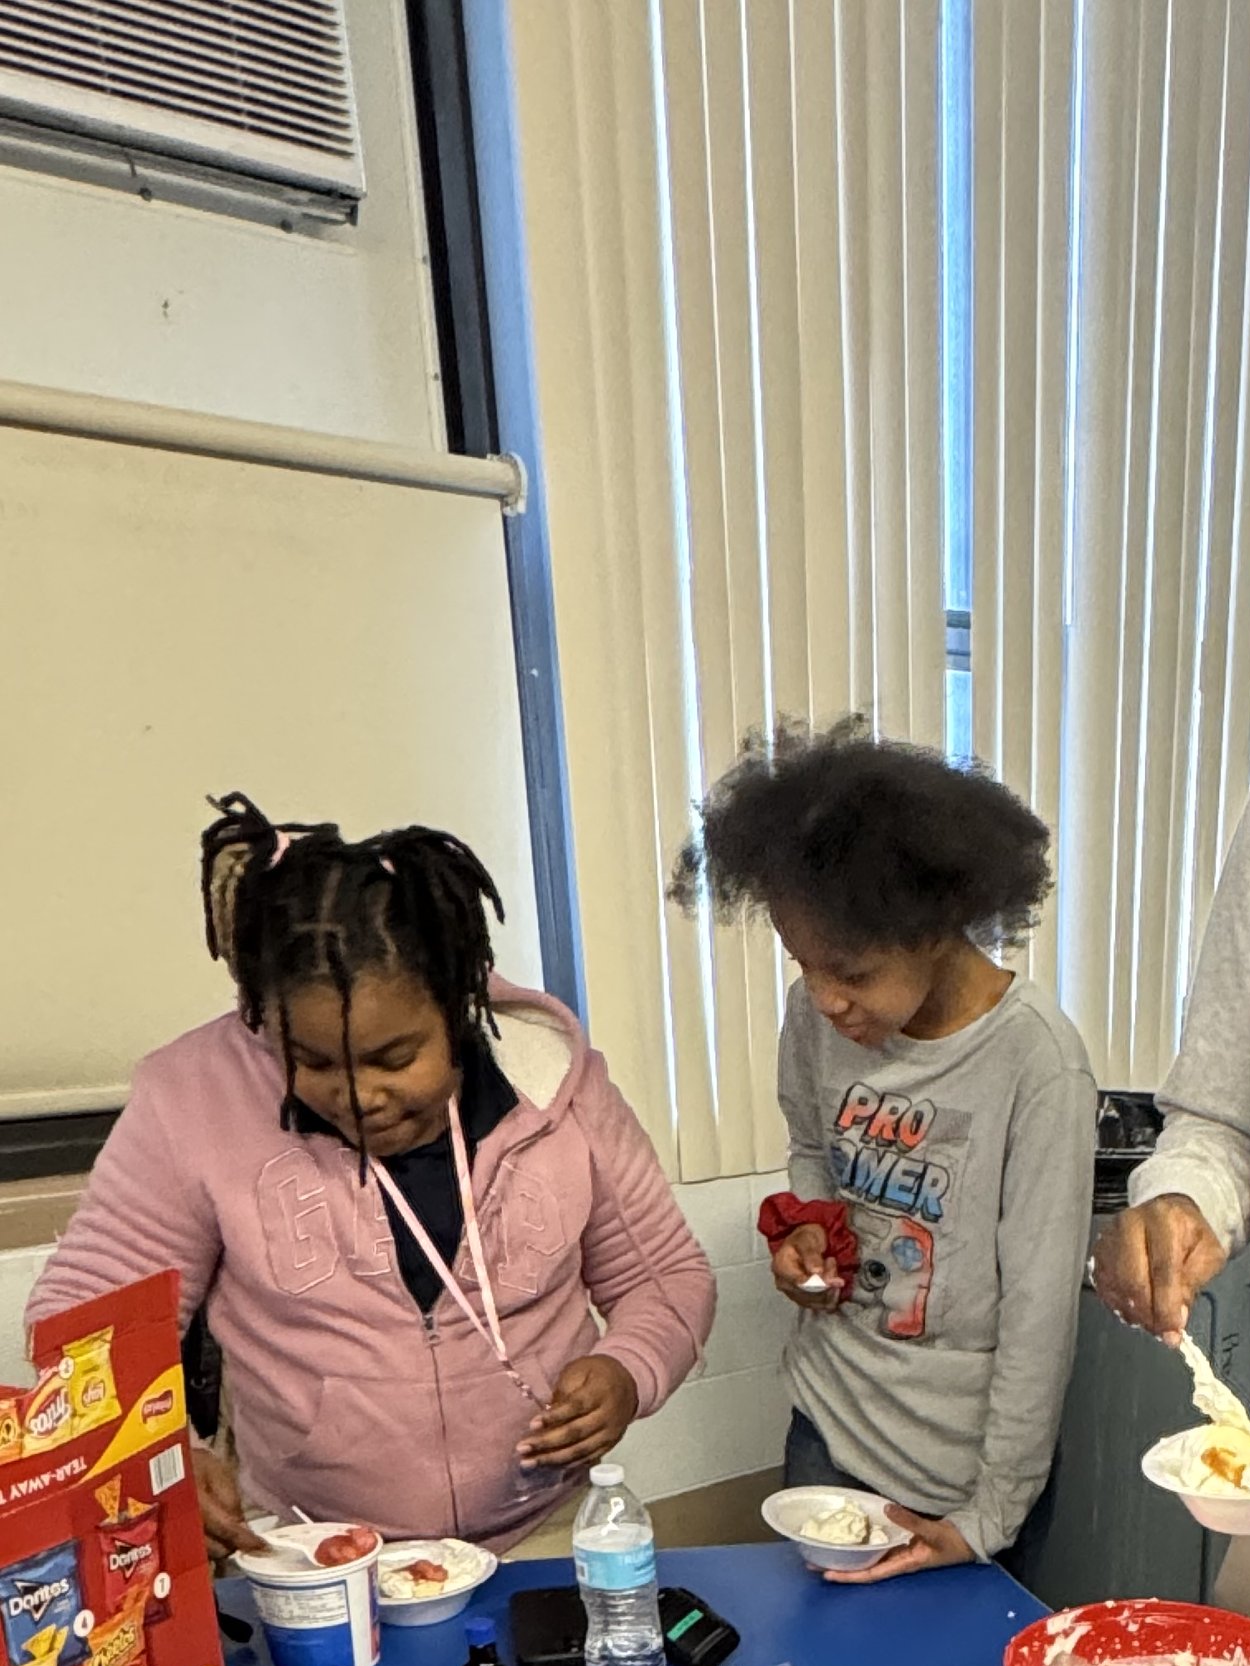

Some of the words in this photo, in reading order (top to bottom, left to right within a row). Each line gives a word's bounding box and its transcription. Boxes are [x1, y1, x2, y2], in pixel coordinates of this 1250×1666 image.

[834, 1082, 937, 1153] PRO
[30, 1387, 71, 1436] Fritos
[9, 1456, 87, 1501] TEAR-AWAY
[108, 1544, 152, 1571] Doritos
[9, 1577, 70, 1617] Doritos
